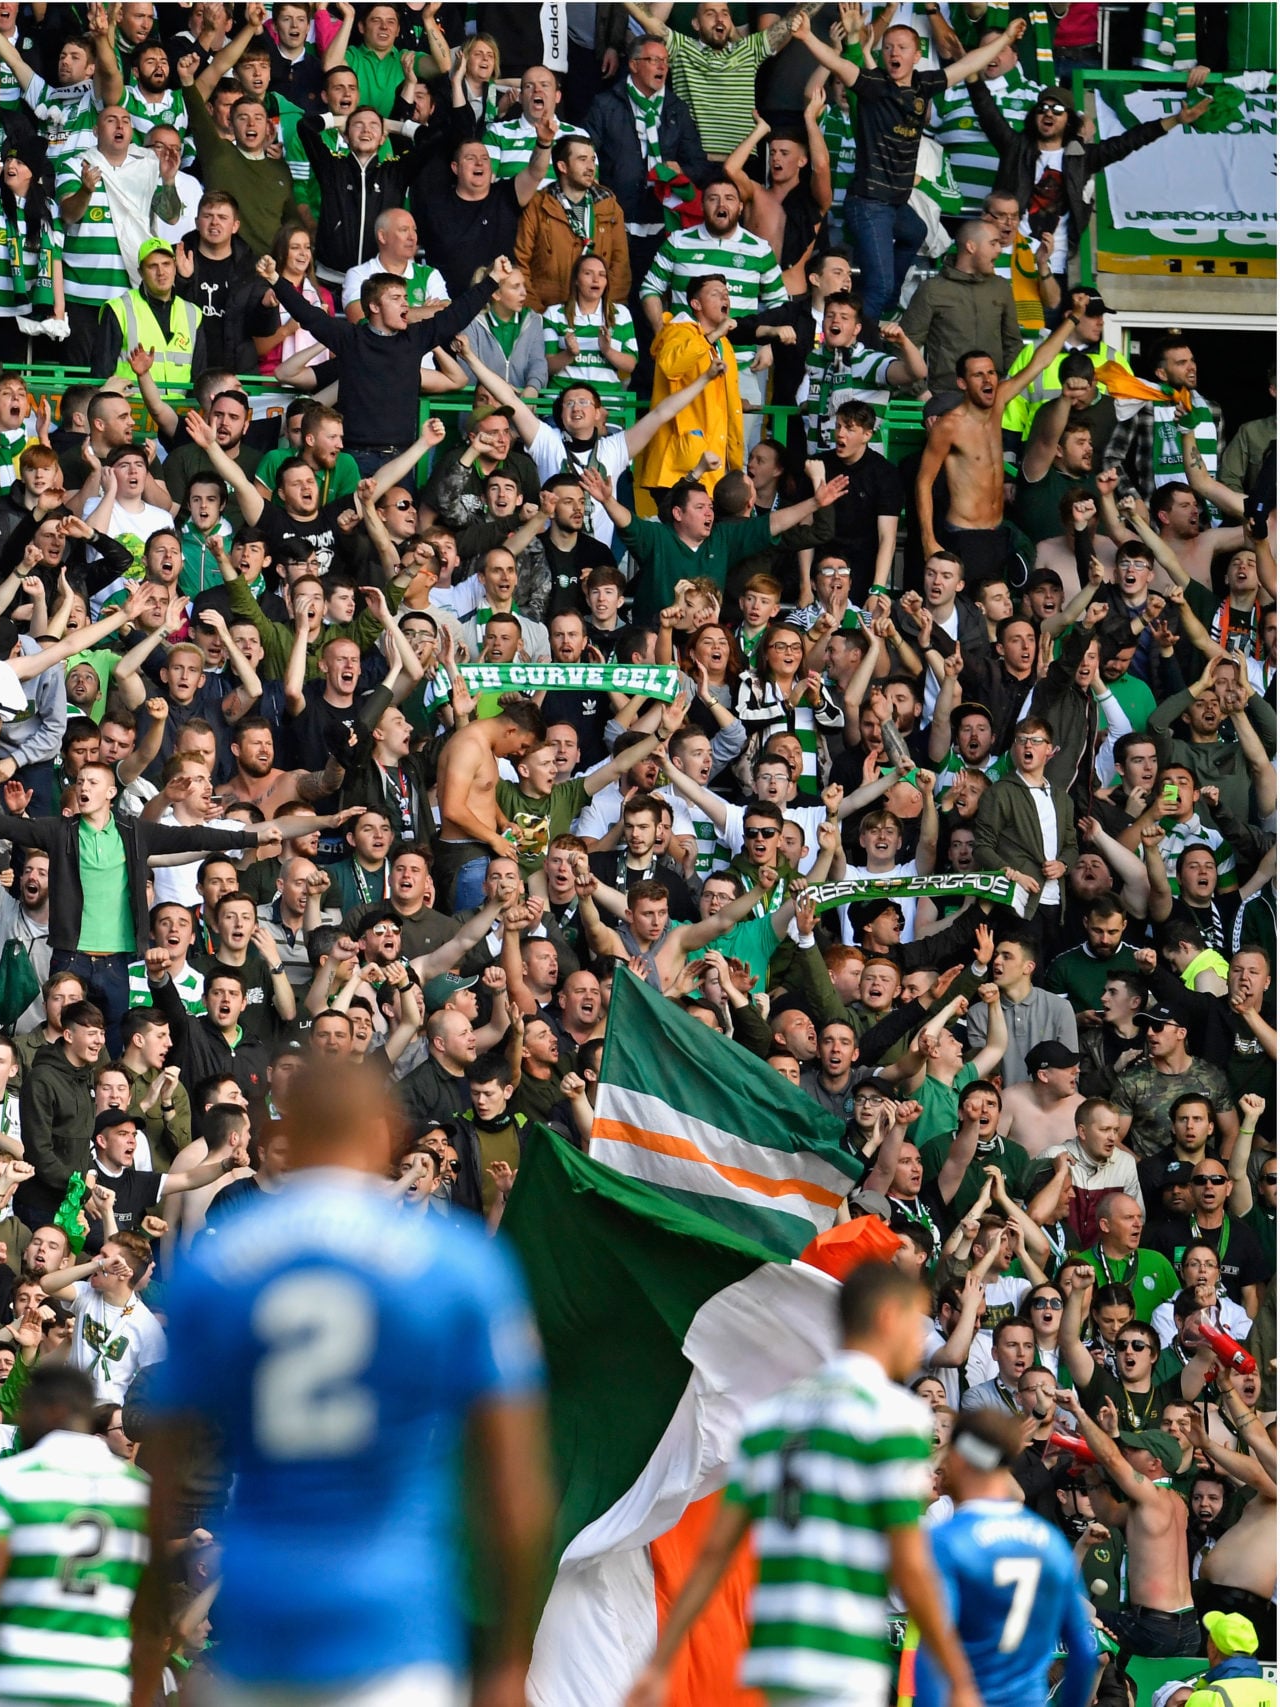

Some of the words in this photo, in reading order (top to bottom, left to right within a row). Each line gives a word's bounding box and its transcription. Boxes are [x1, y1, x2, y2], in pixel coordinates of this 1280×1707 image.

[549, 2, 560, 60] adida
[1124, 210, 1258, 222] UNBROKEN
[509, 666, 604, 686] CURVE
[251, 1266, 378, 1460] 2
[55, 1507, 116, 1597] 2
[993, 1556, 1043, 1653] 7
